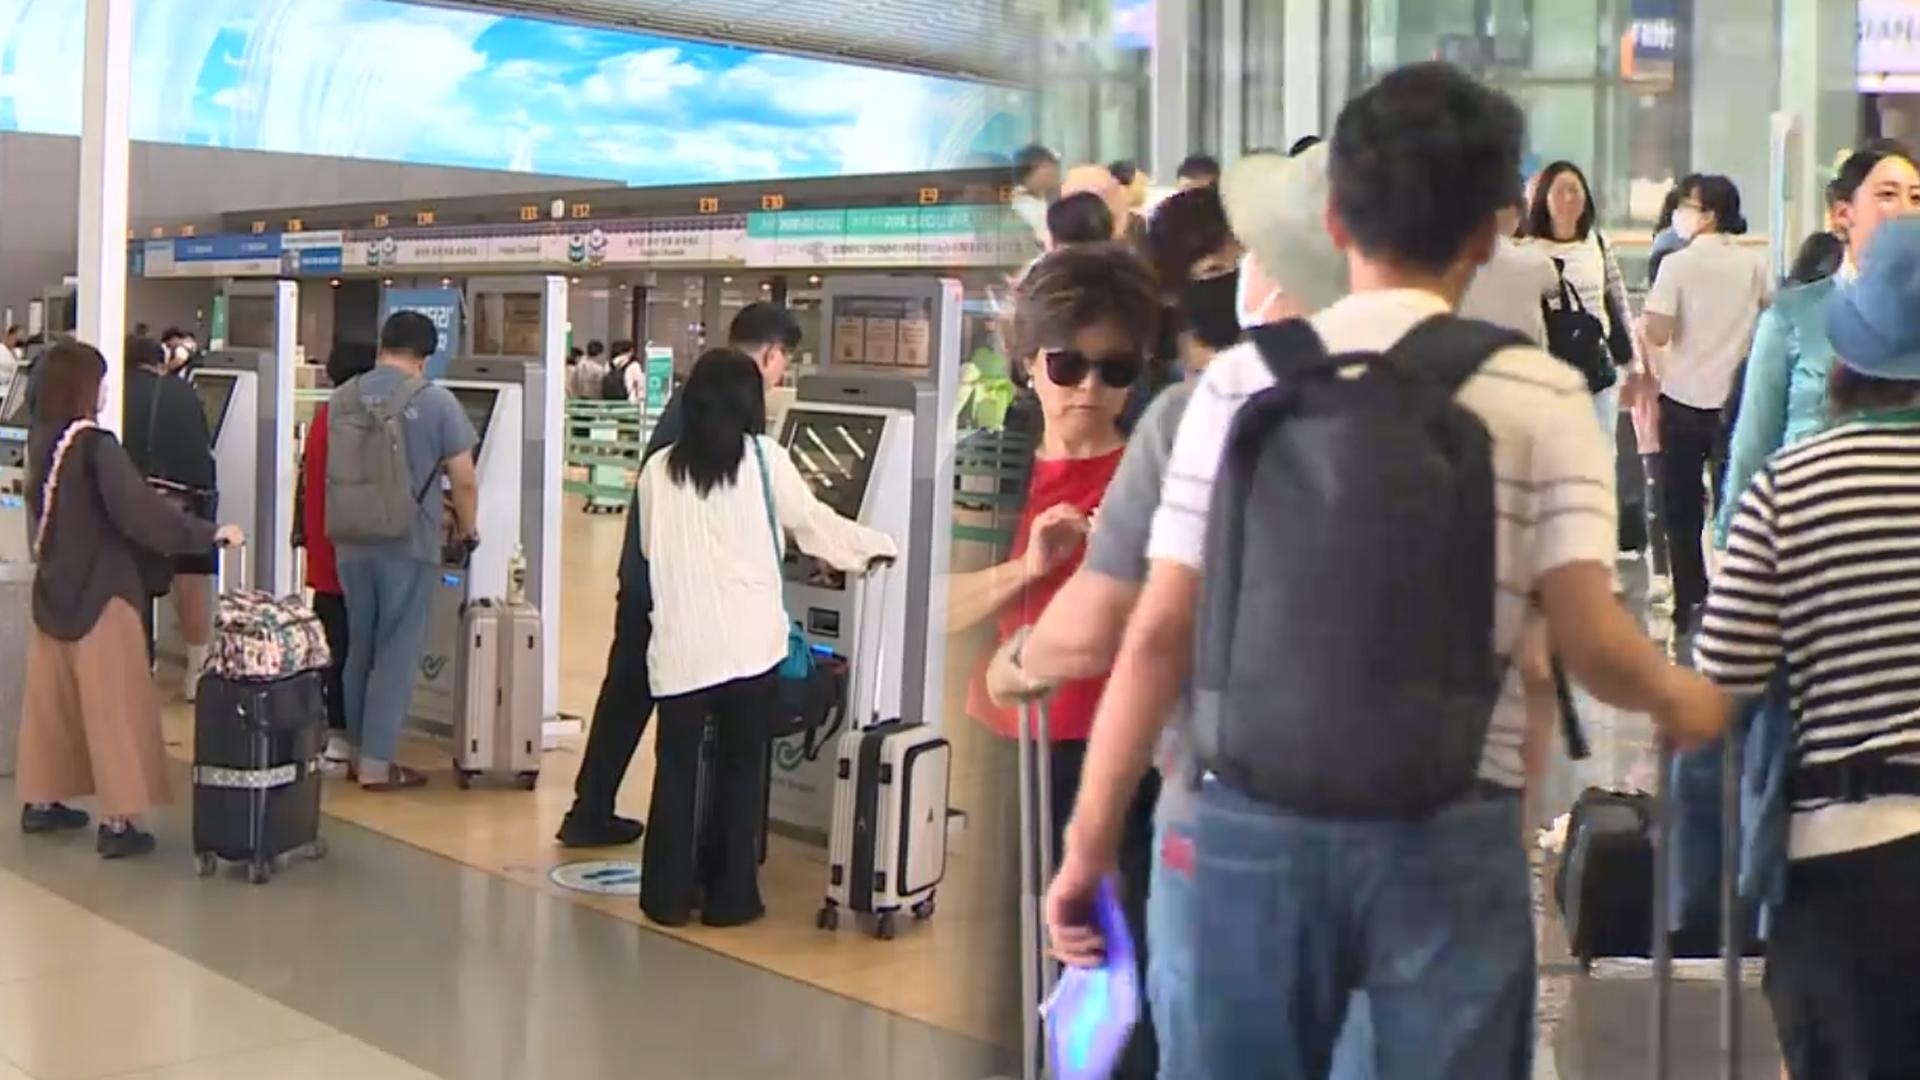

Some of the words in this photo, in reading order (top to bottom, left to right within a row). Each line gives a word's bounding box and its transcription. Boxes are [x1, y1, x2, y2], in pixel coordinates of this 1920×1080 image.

[762, 194, 783, 210] E10
[920, 187, 938, 205] E9
[571, 203, 590, 219] E12
